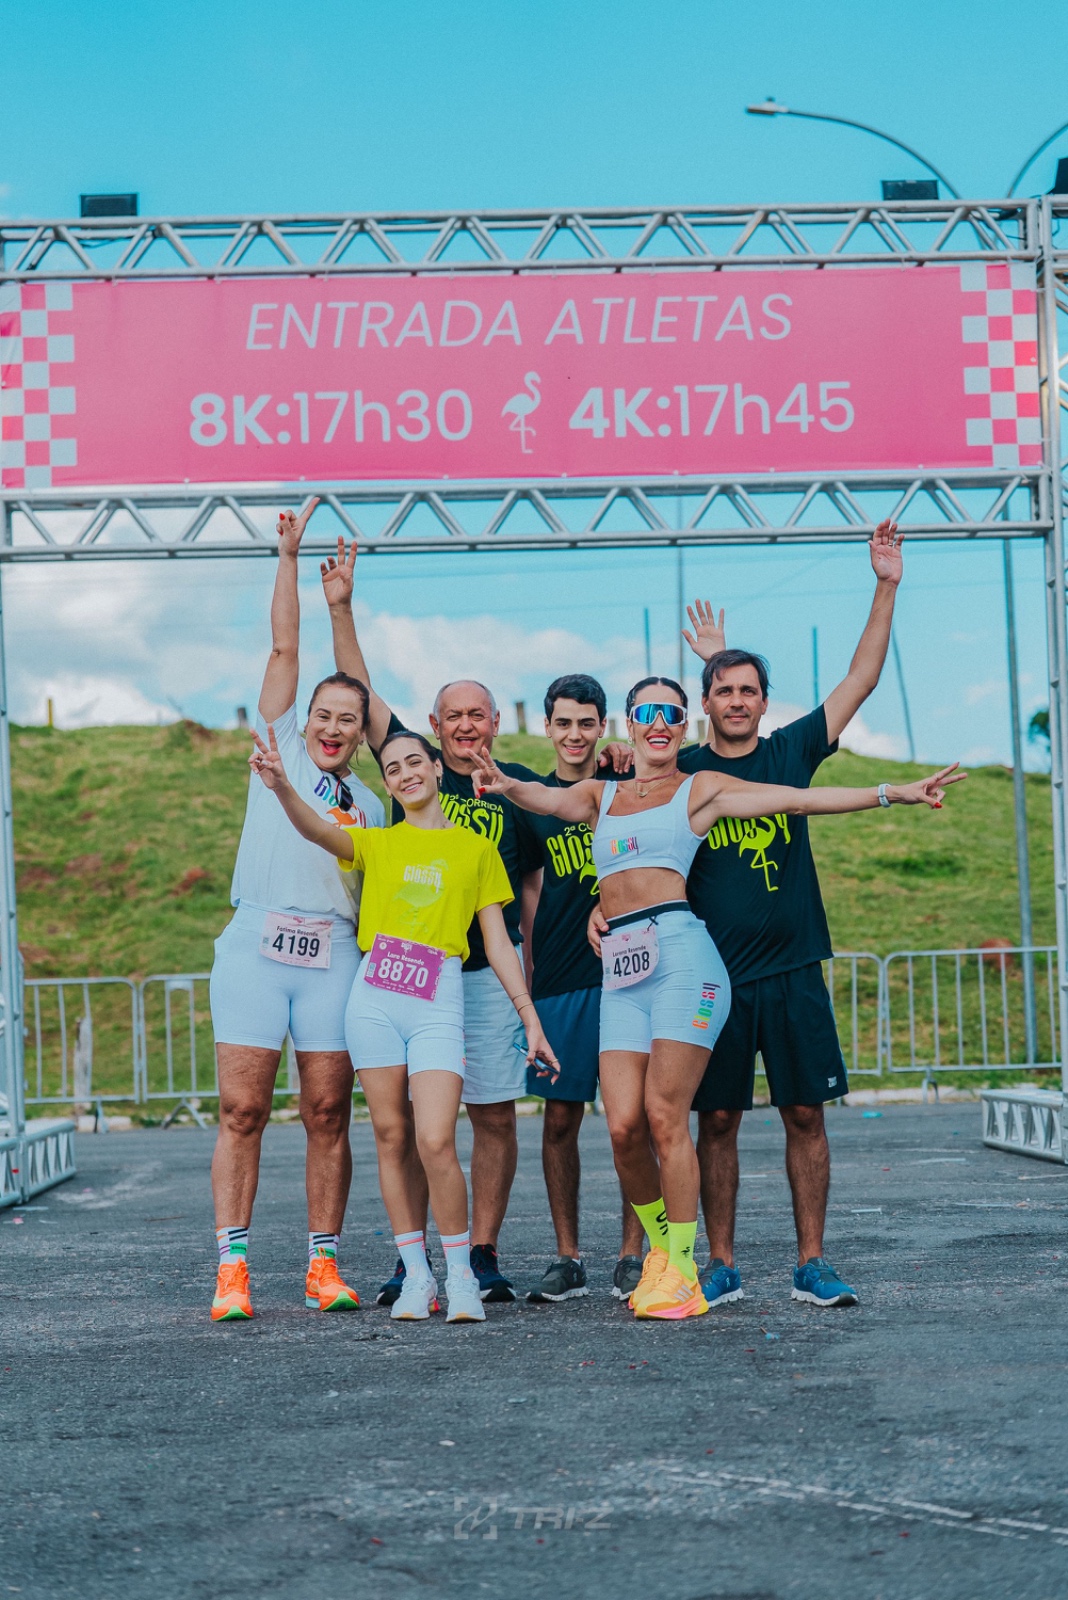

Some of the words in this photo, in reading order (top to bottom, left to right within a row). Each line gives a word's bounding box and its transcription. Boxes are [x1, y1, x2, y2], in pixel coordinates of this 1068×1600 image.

[246, 301, 522, 351] ENTRADA
[545, 293, 793, 344] ATLETAS
[189, 389, 473, 447] 8K:17h30
[569, 381, 855, 438] 4K:17h45
[403, 864, 442, 894] Glossy
[272, 932, 320, 958] 4199
[377, 958, 429, 989] 8870
[613, 951, 650, 977] 4208
[692, 982, 721, 1030] Glossy
